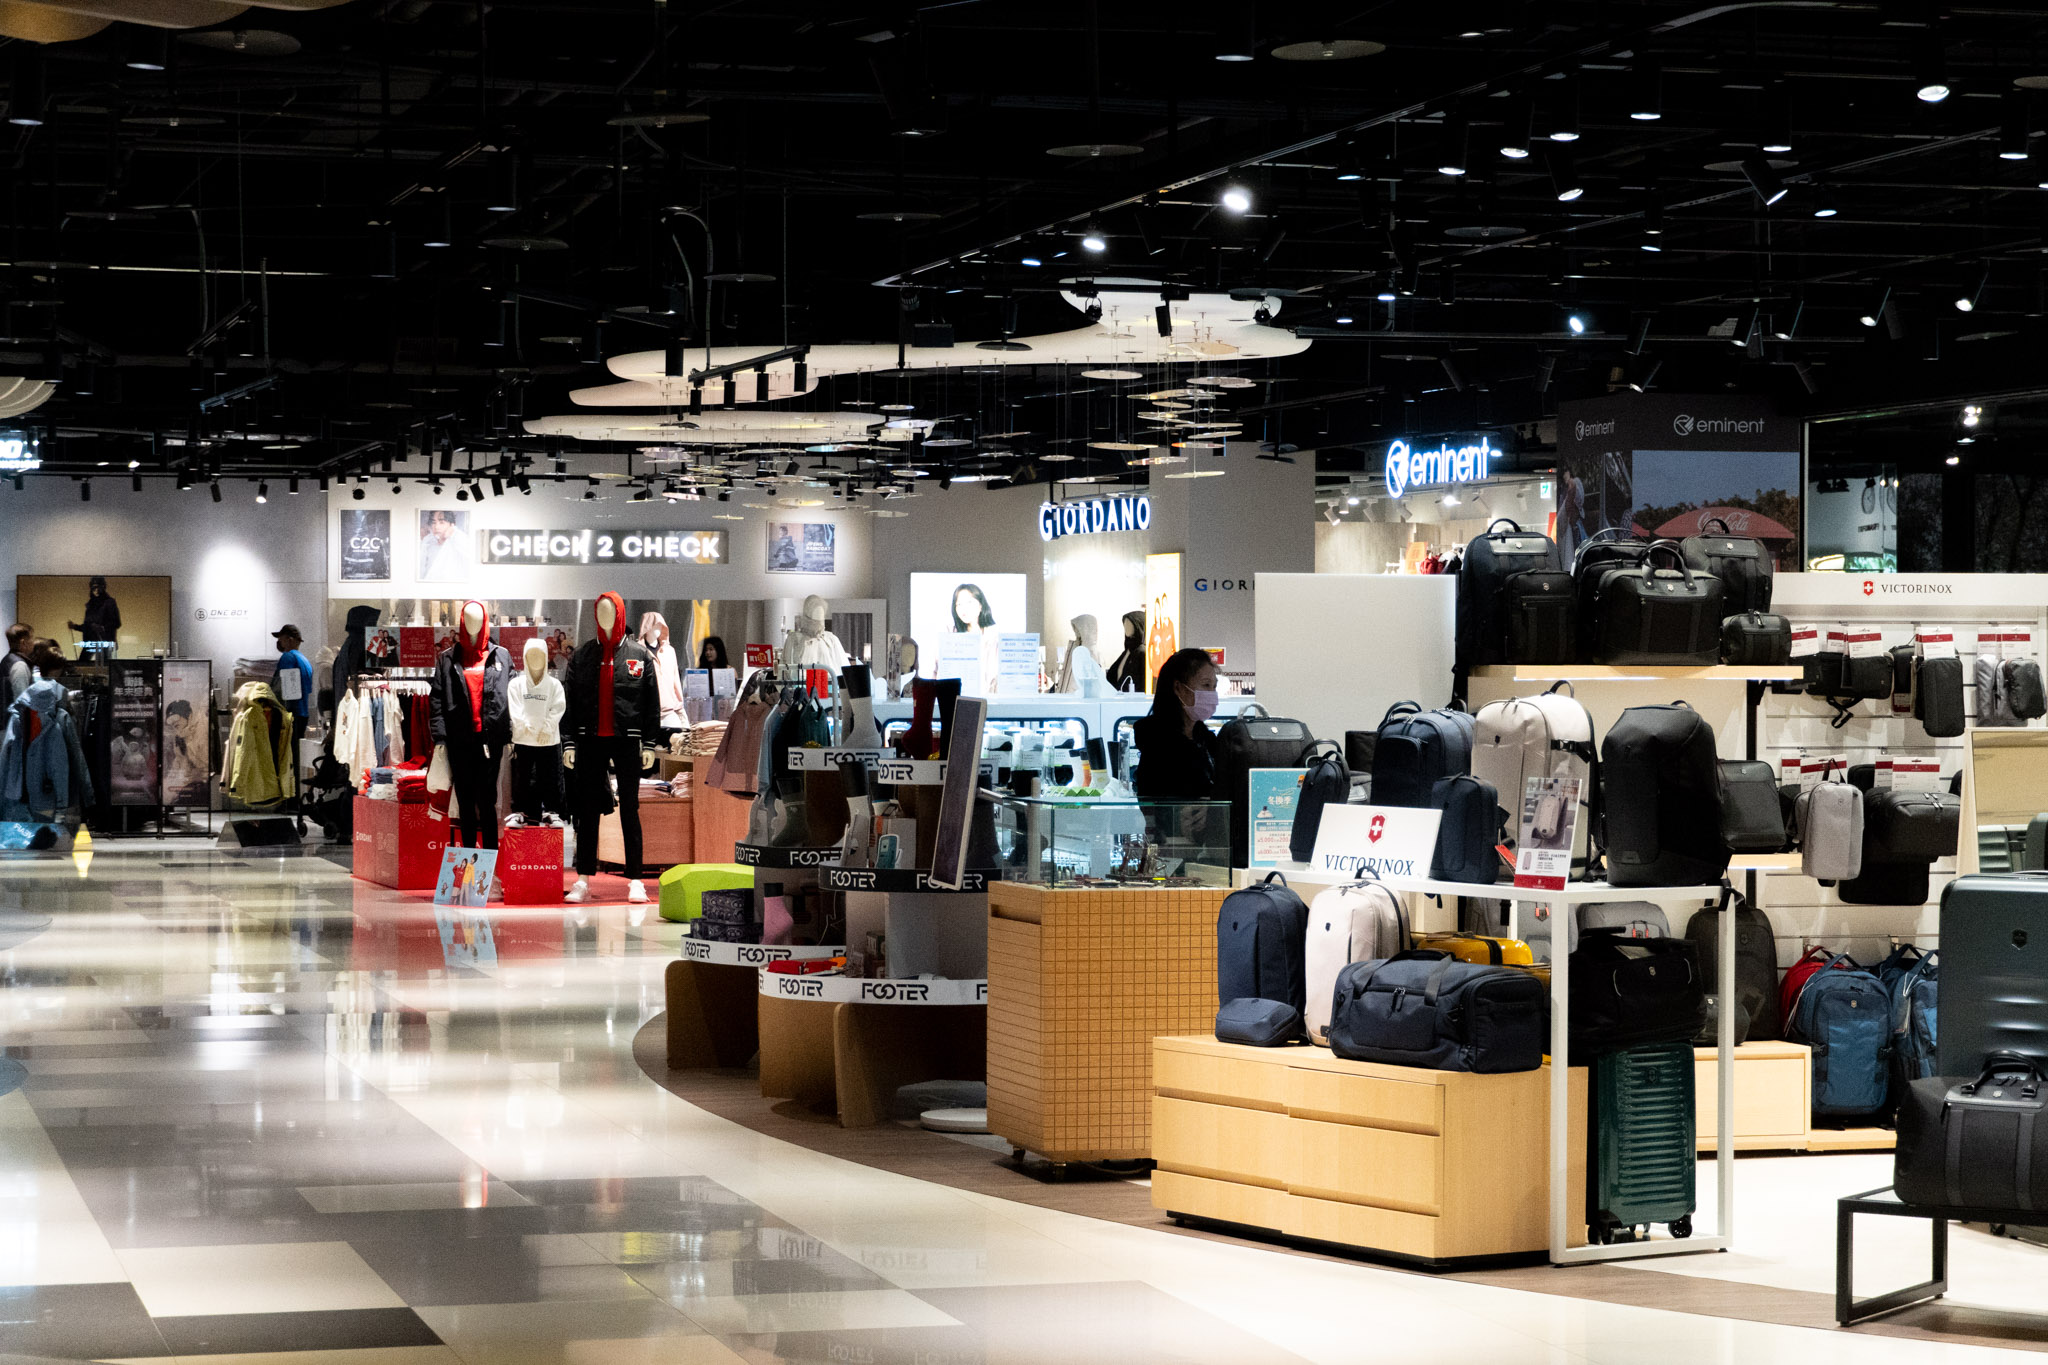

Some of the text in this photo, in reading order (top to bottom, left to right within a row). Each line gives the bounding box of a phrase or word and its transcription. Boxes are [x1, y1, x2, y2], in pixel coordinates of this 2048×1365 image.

[1585, 419, 1615, 437] eminent
[1697, 417, 1765, 434] eminent
[1410, 436, 1490, 486] eminent
[1039, 497, 1151, 541] GIORDANO
[350, 537, 380, 549] C2C
[490, 535, 720, 558] CHECK 2 CHECK
[1194, 578, 1255, 591] GIOR
[1881, 584, 1952, 594] VICTORINOX
[735, 846, 761, 863] FOOTER
[1326, 854, 1415, 876] VICTORINOX
[830, 870, 877, 888] FOOTER
[685, 941, 711, 959] FOOTER
[779, 977, 823, 998] FOOTER
[862, 982, 929, 1001] FOOTER
